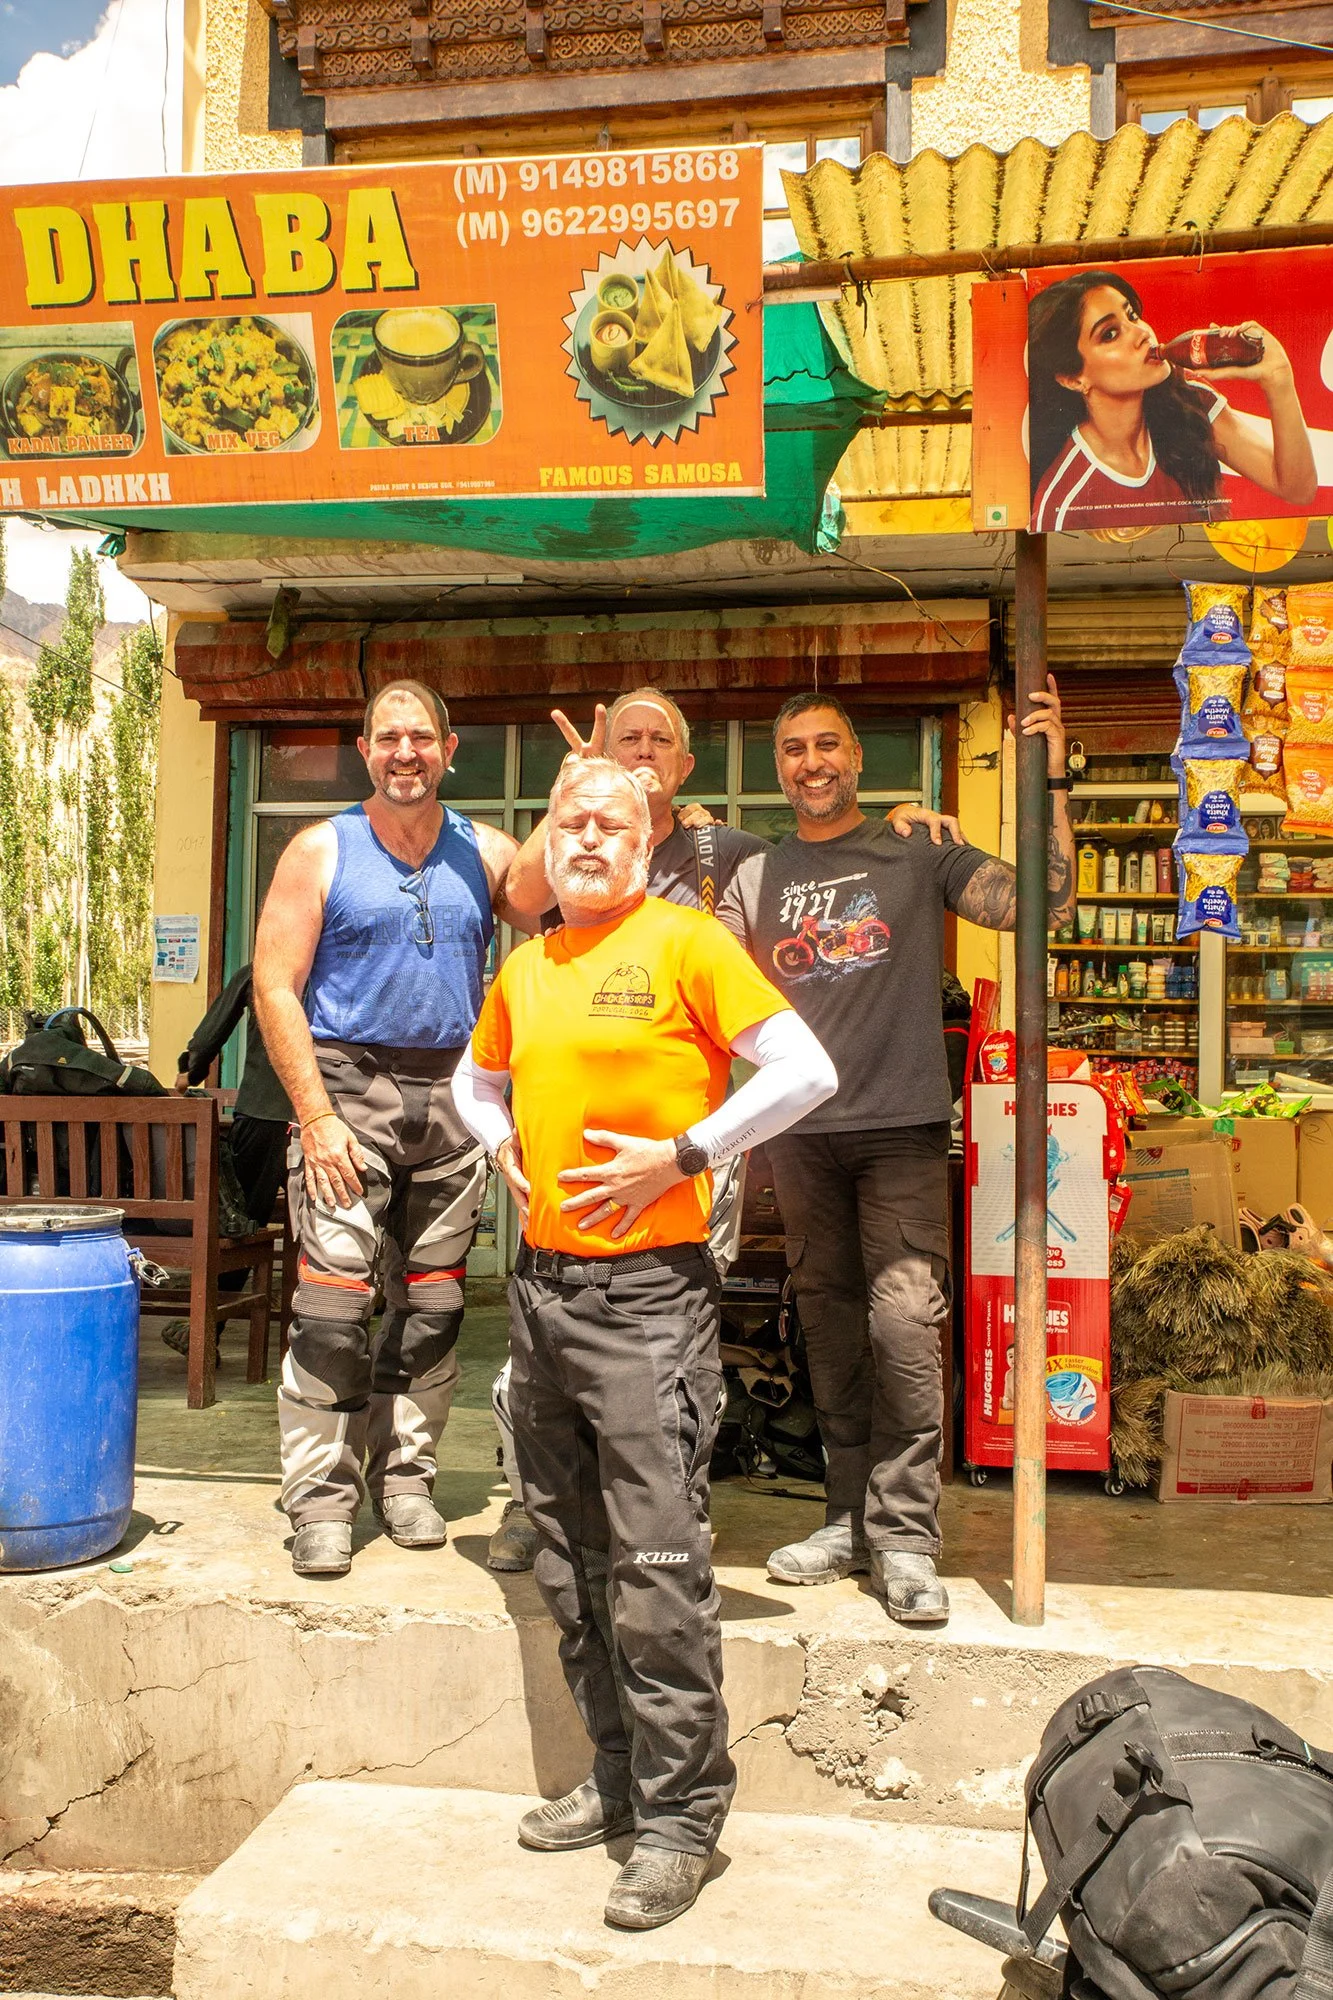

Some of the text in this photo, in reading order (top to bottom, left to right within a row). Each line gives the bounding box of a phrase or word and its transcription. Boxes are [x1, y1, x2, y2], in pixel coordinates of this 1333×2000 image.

[453, 151, 740, 203] (M) 9149815868
[456, 198, 741, 248] (M) 9622995697
[14, 187, 419, 309] DHABA
[207, 431, 281, 449] MIX VEG
[403, 425, 440, 442] TEA
[8, 434, 134, 454] KADAI PANEER
[539, 462, 743, 487] FAMOUS SAMOSA
[36, 472, 172, 505] LADHKH
[780, 880, 817, 900] since
[1202, 898, 1227, 906] Meetha
[1203, 904, 1226, 912] Khatta
[332, 904, 484, 945] SINGHA
[337, 951, 371, 959] PREMIUM
[1004, 1101, 1078, 1116] HGIES
[1003, 1304, 1068, 1326] HIES
[1064, 1363, 1099, 1375] Absorption
[983, 1348, 993, 1416] HUGGIES
[1048, 1408, 1057, 1420] Dry
[633, 1552, 689, 1564] Klim
